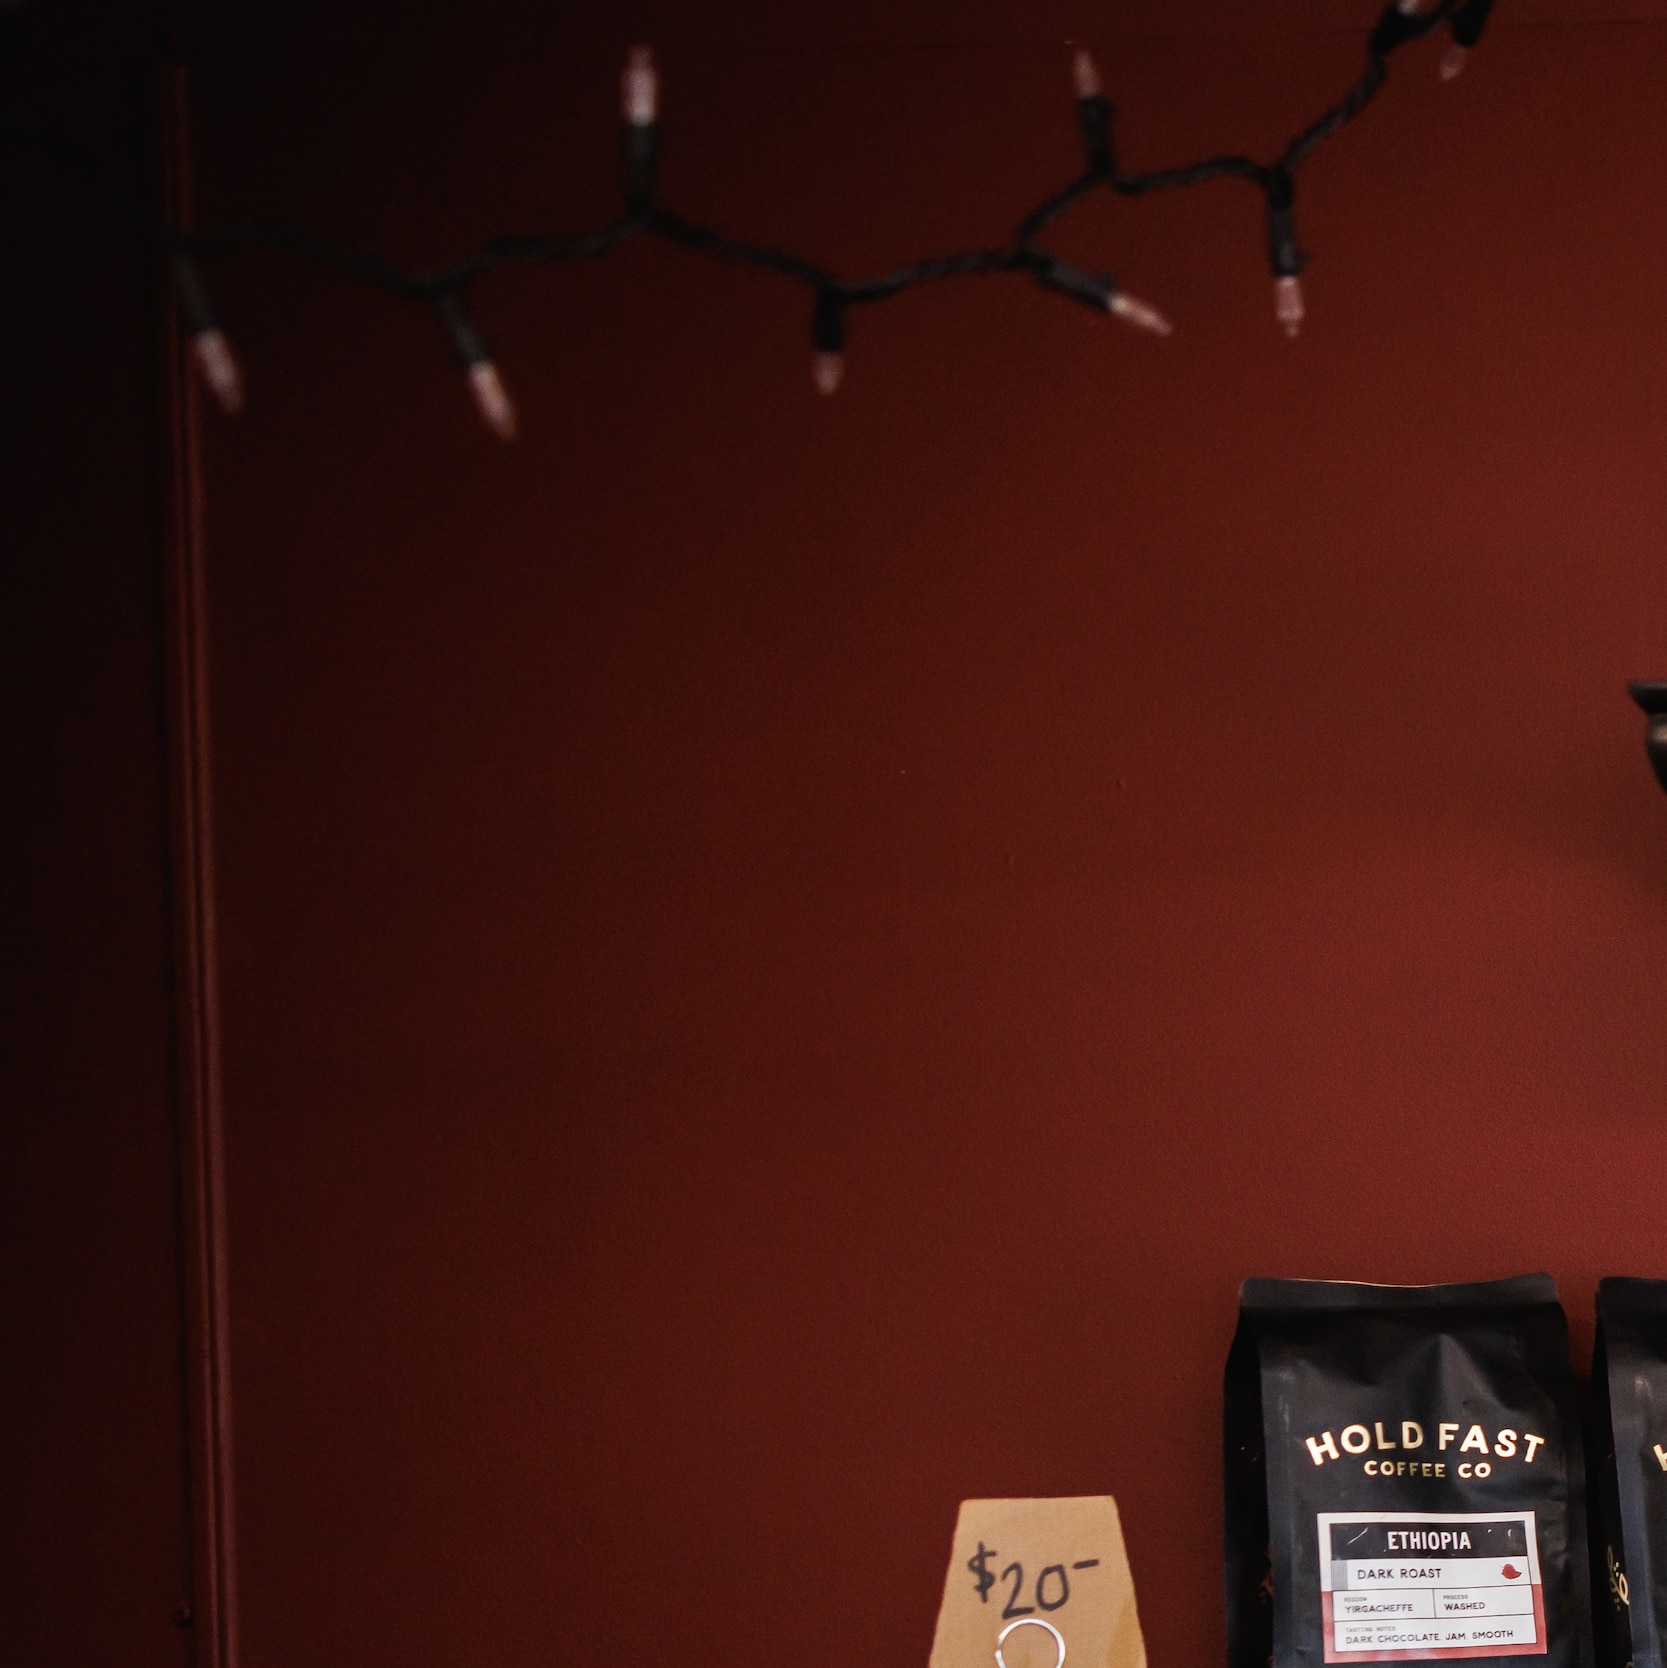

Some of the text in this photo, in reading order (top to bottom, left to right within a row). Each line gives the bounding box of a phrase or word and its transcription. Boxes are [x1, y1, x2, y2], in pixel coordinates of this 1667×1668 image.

[1305, 1421, 1545, 1466] HOLD FAST
[1363, 1460, 1492, 1479] COFFEE CO
[1387, 1530, 1472, 1551] ETHIOPIA
[1357, 1567, 1442, 1580] DARK ROAST
[1345, 1603, 1413, 1613] YIRGACHEFFE
[1444, 1602, 1485, 1611] WASHED
[1345, 1636, 1373, 1645] DARK
[1472, 1630, 1514, 1639] SMOOTH
